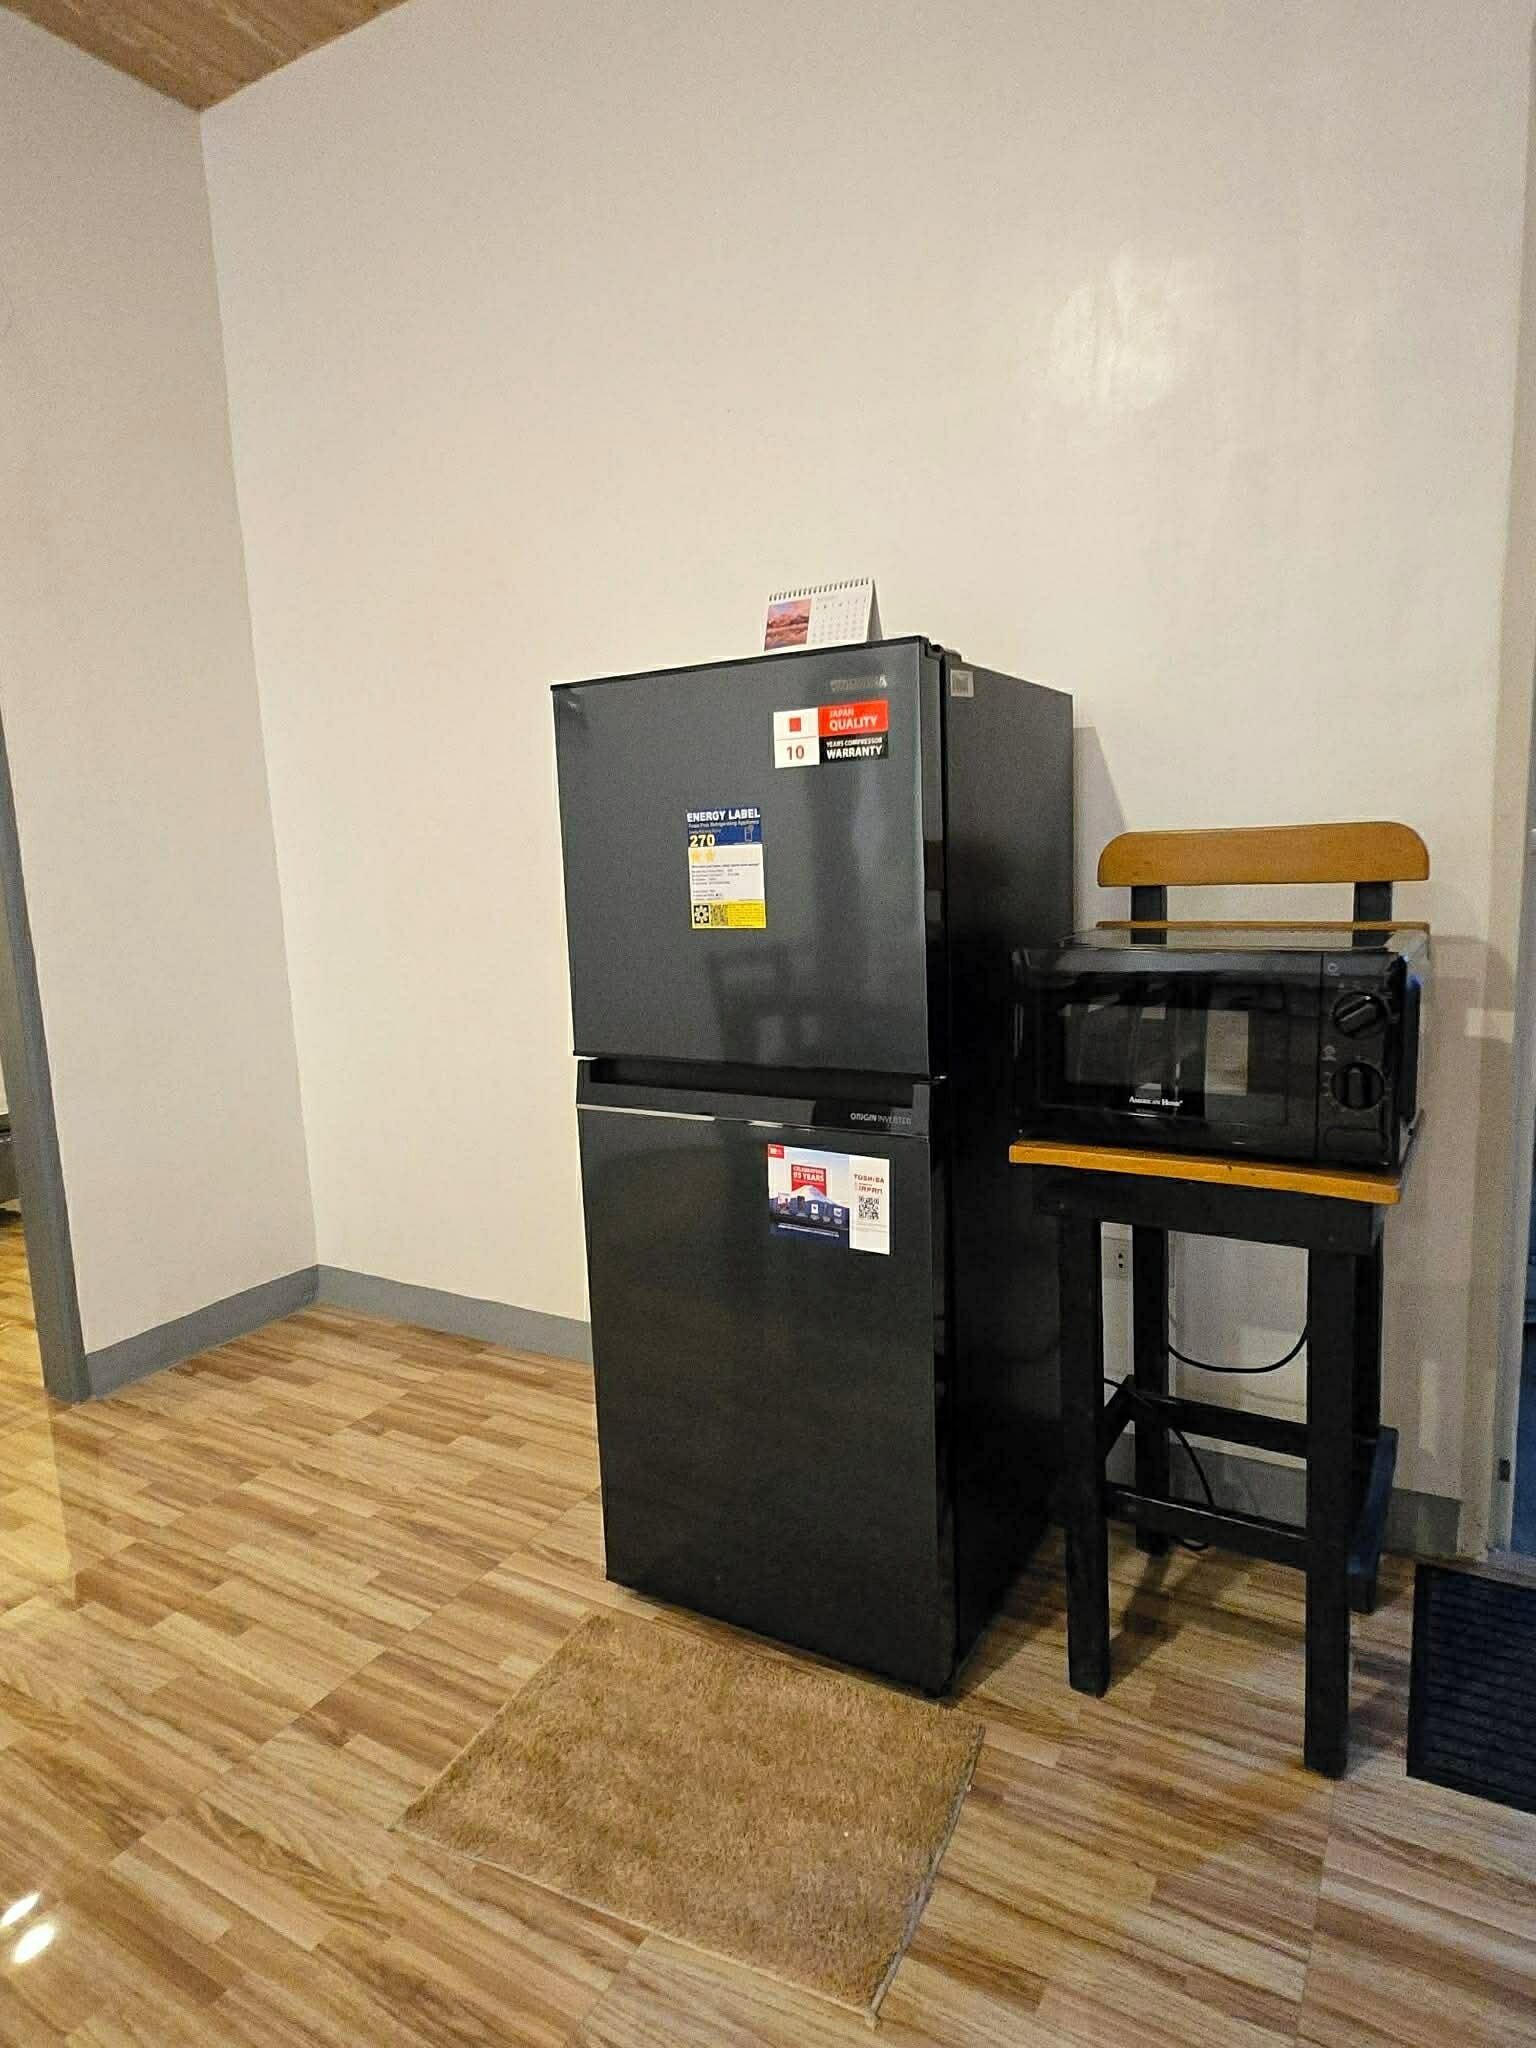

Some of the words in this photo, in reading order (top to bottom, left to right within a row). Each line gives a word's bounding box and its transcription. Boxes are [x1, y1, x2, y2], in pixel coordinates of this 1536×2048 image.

[829, 707, 854, 718] JAPAN
[829, 715, 878, 732] QUALITY
[826, 740, 844, 748] YEARS
[786, 745, 805, 760] 10
[826, 745, 882, 760] WARRANTY
[687, 810, 726, 823] ENERGY
[728, 808, 761, 820] LABEL
[689, 834, 716, 848] 270
[802, 1173, 825, 1183] YEARS
[853, 1173, 885, 1184] TOSHIBA
